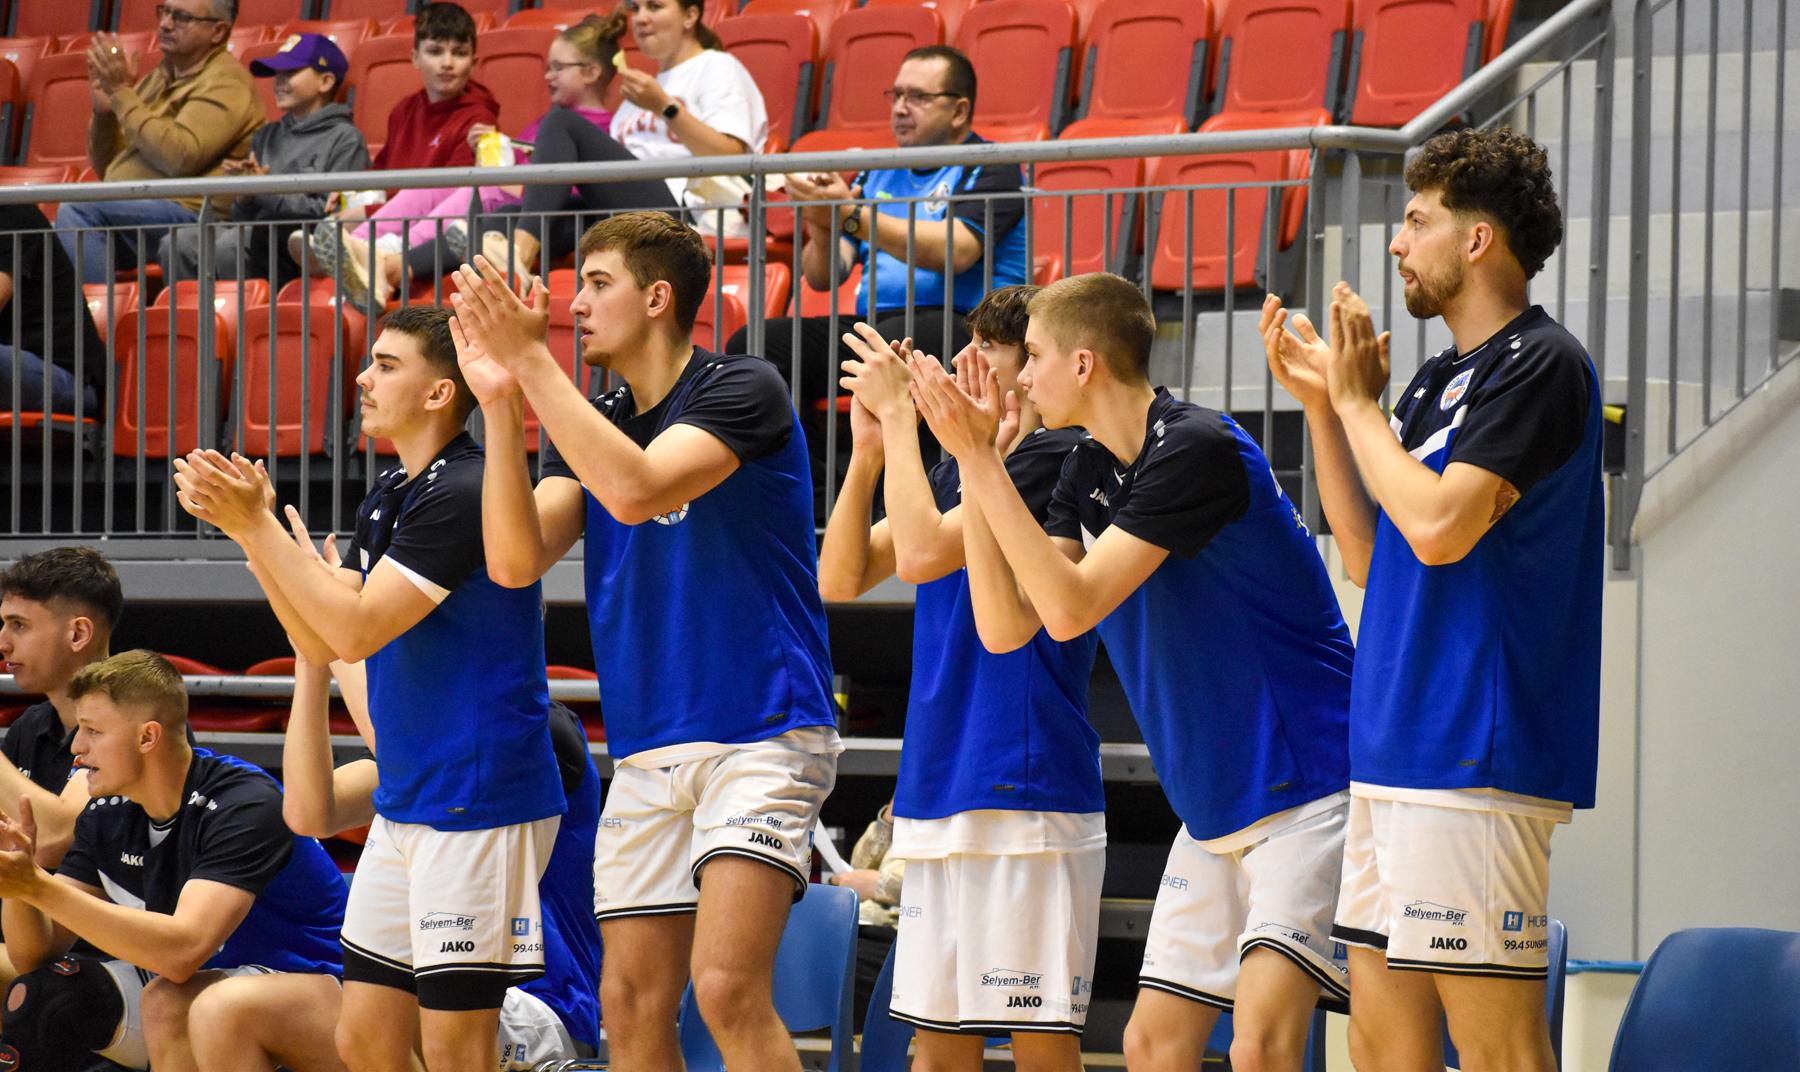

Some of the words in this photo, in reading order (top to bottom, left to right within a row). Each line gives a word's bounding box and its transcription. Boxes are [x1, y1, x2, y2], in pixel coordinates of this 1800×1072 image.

[725, 815, 783, 828] Selyem-Ber
[748, 832, 783, 850] JAKO
[1403, 906, 1467, 920] Selyem-Ber
[420, 917, 475, 929] Selyem-Ber
[440, 940, 476, 953] JAKO
[513, 943, 534, 953] 99.4
[1430, 936, 1468, 951] JAKO
[981, 975, 1041, 986] Selyem-Ber
[1006, 995, 1043, 1008] JAKO
